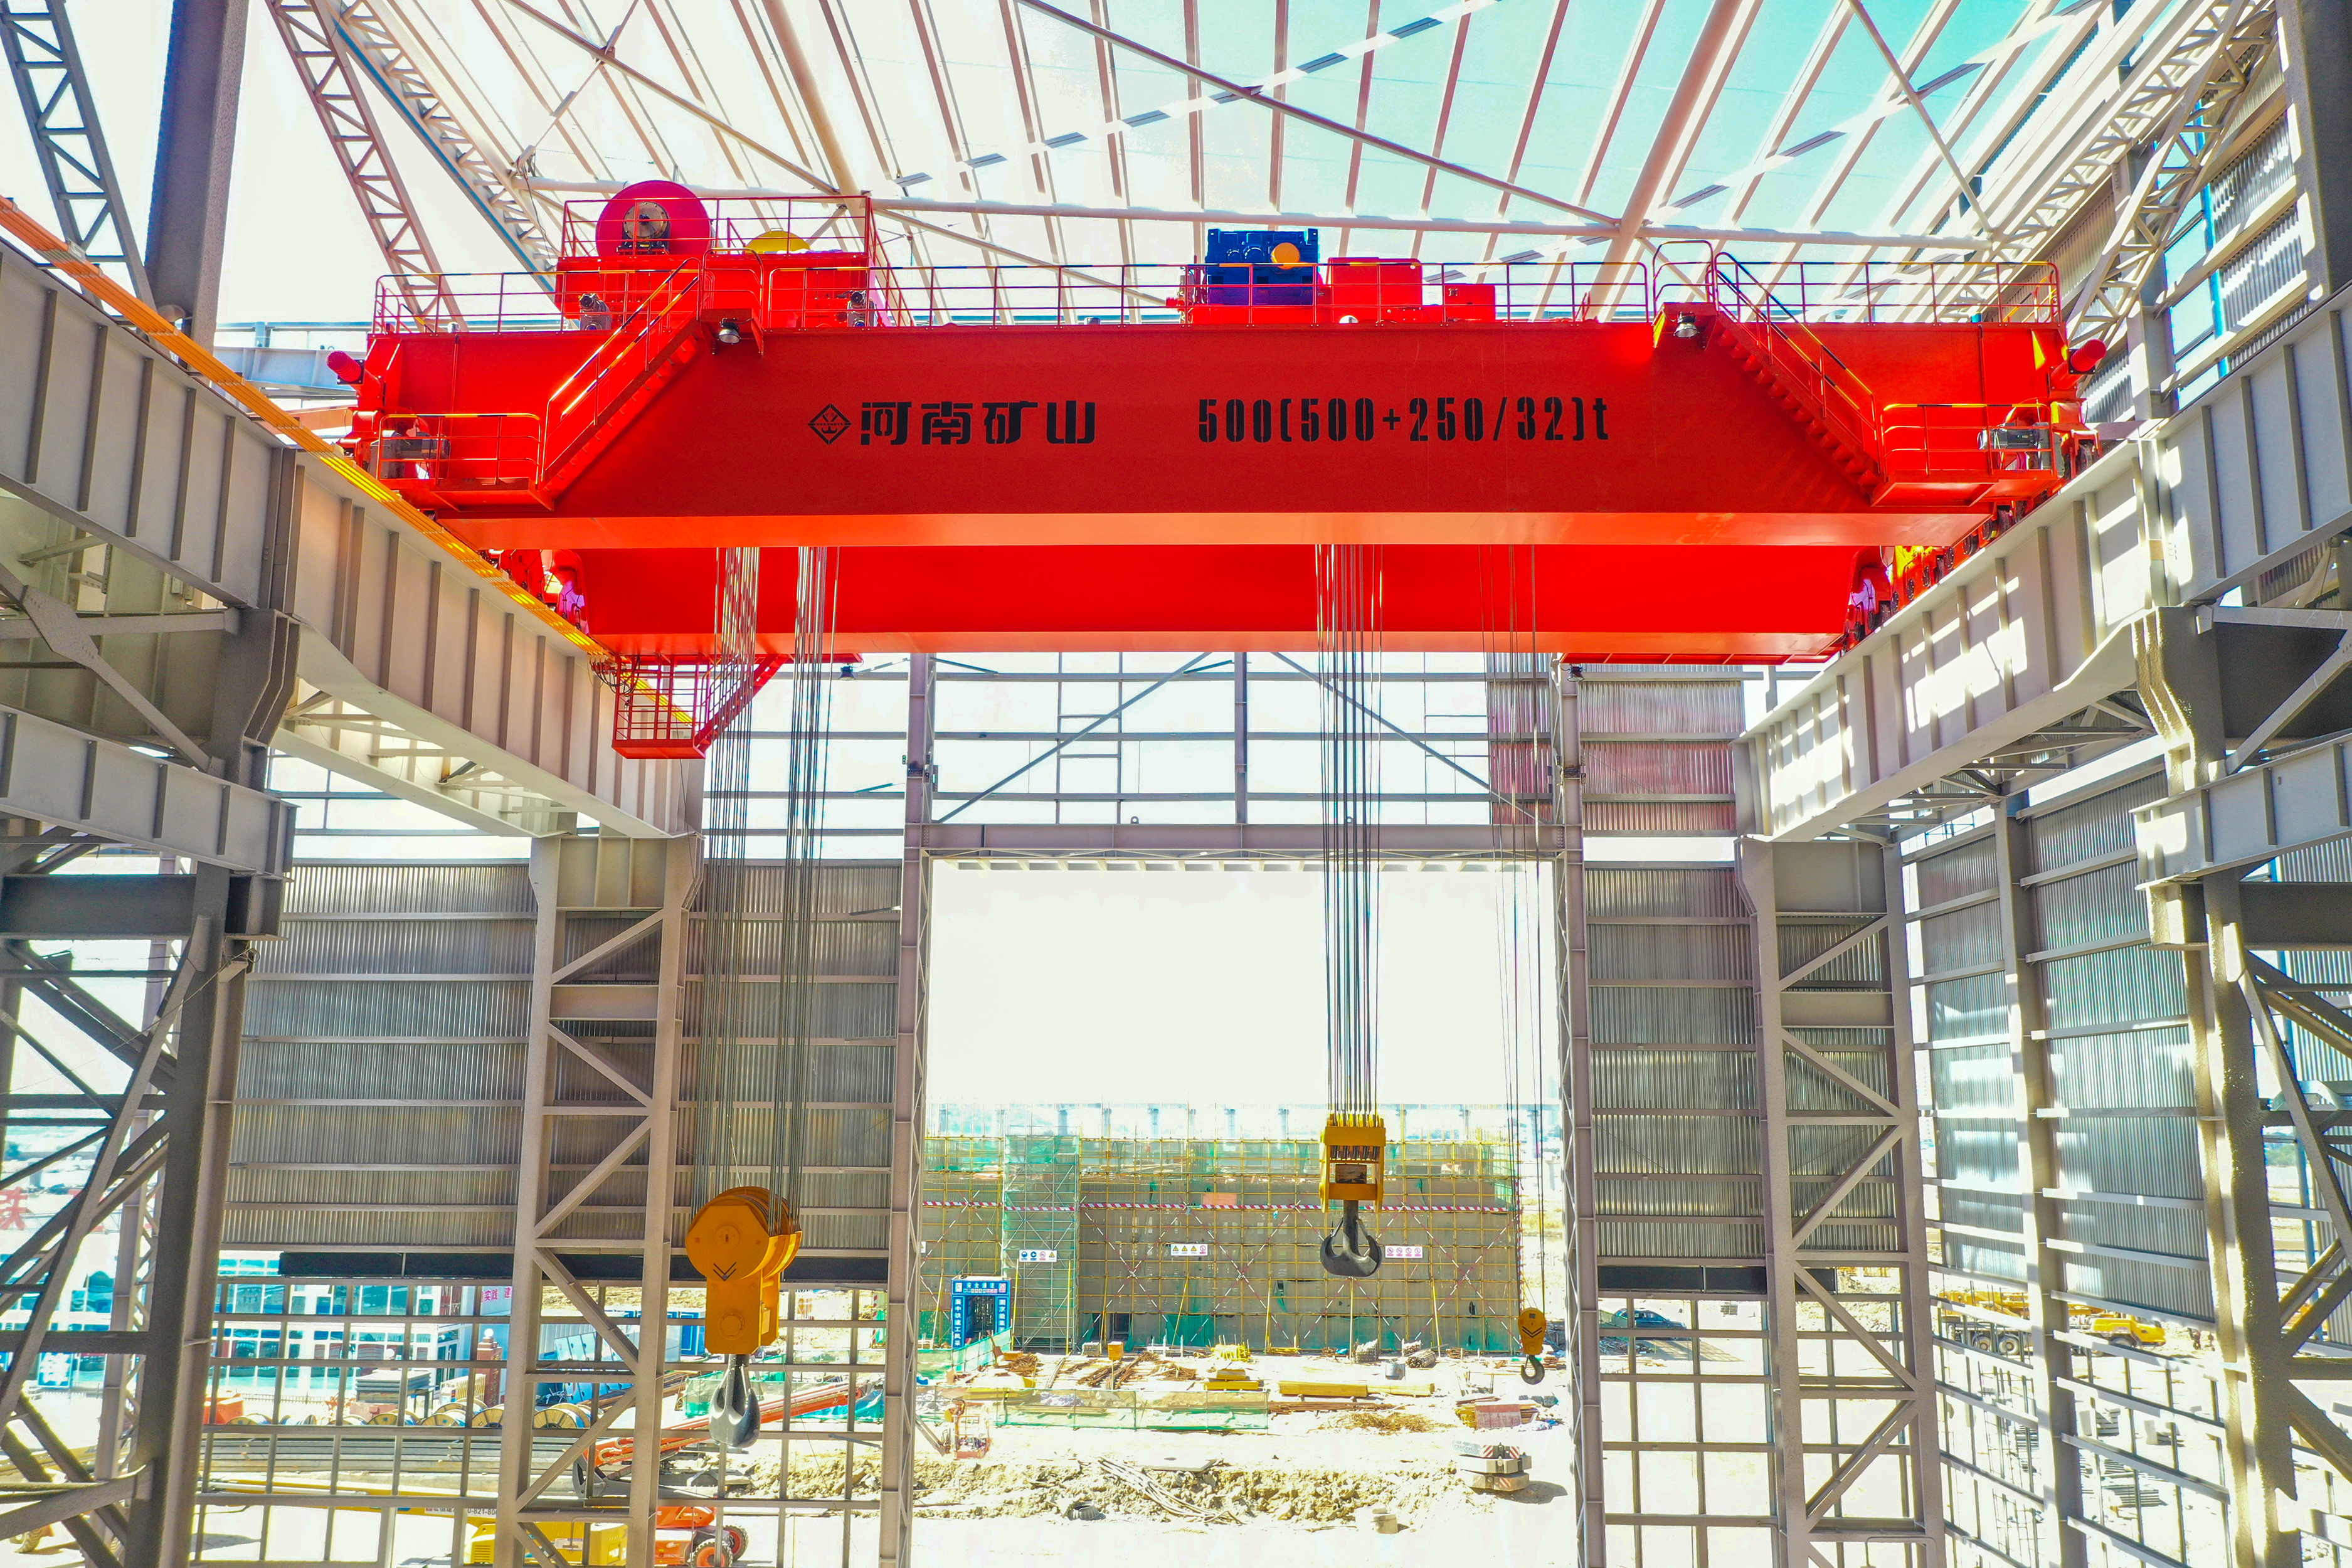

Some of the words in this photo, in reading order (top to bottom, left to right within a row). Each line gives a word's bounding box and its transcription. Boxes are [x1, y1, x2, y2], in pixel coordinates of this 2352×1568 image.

[861, 400, 1096, 445] 河南矿山
[1199, 396, 1609, 443] 500(500+250/32)t
